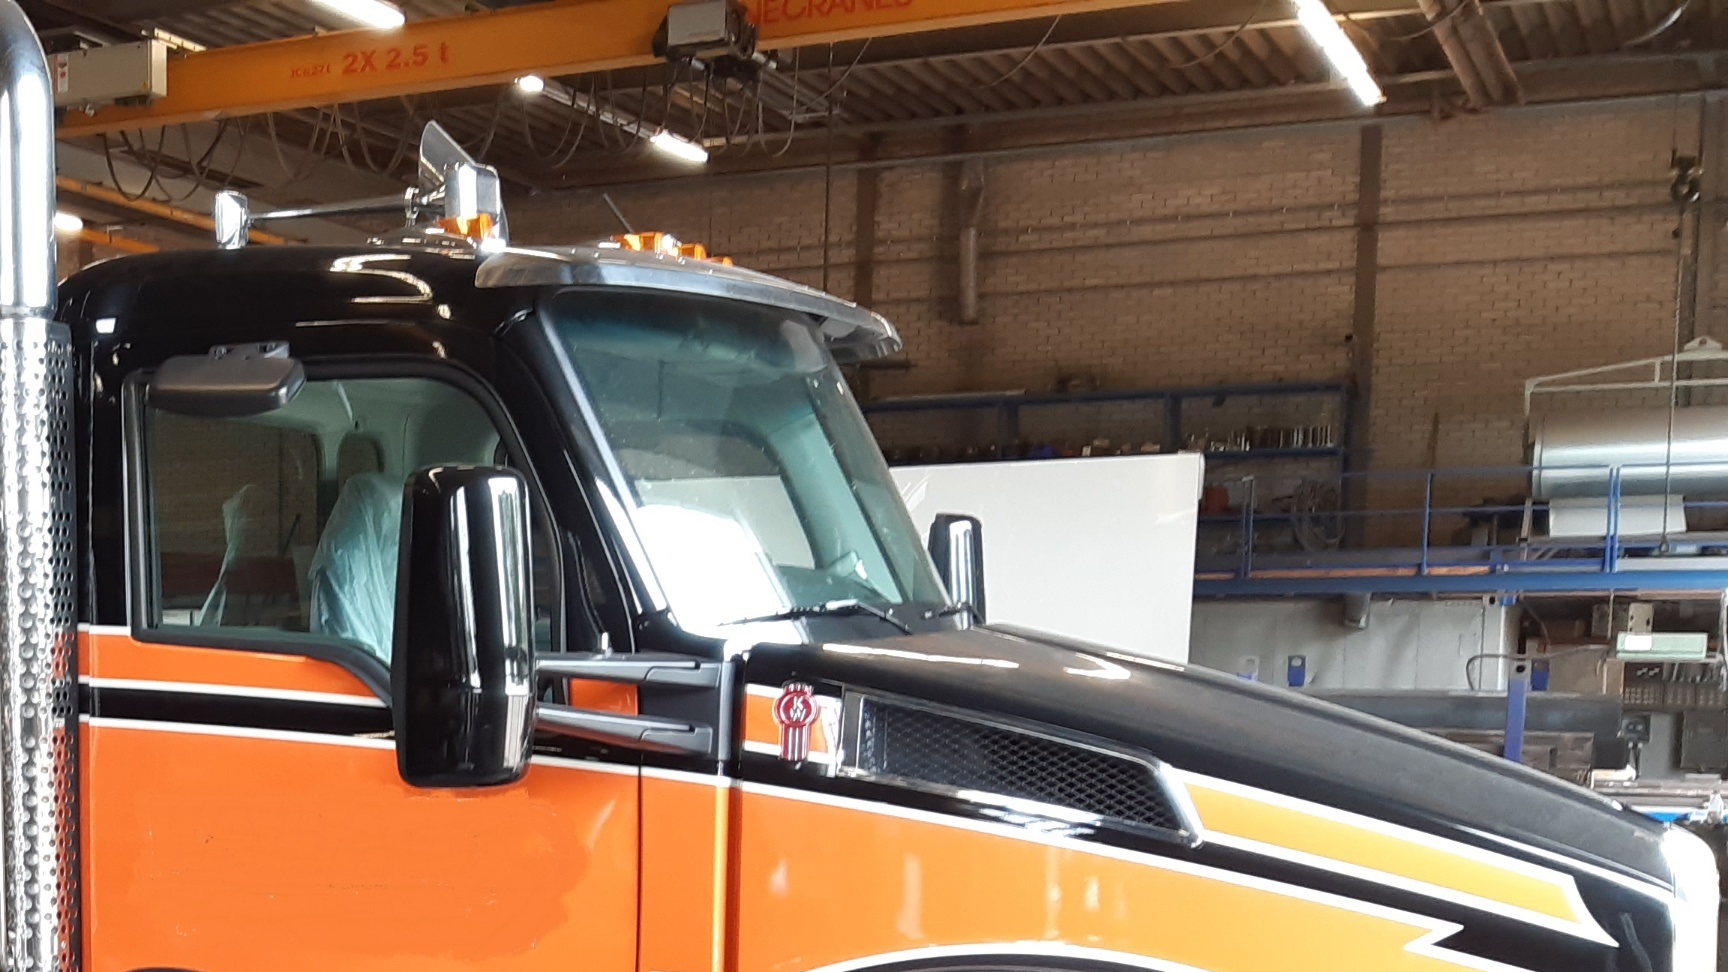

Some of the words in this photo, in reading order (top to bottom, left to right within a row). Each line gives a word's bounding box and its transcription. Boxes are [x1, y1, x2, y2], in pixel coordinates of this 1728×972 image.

[745, 0, 913, 24] NECRA
[342, 50, 376, 75] 2X
[385, 44, 429, 71] 2.5
